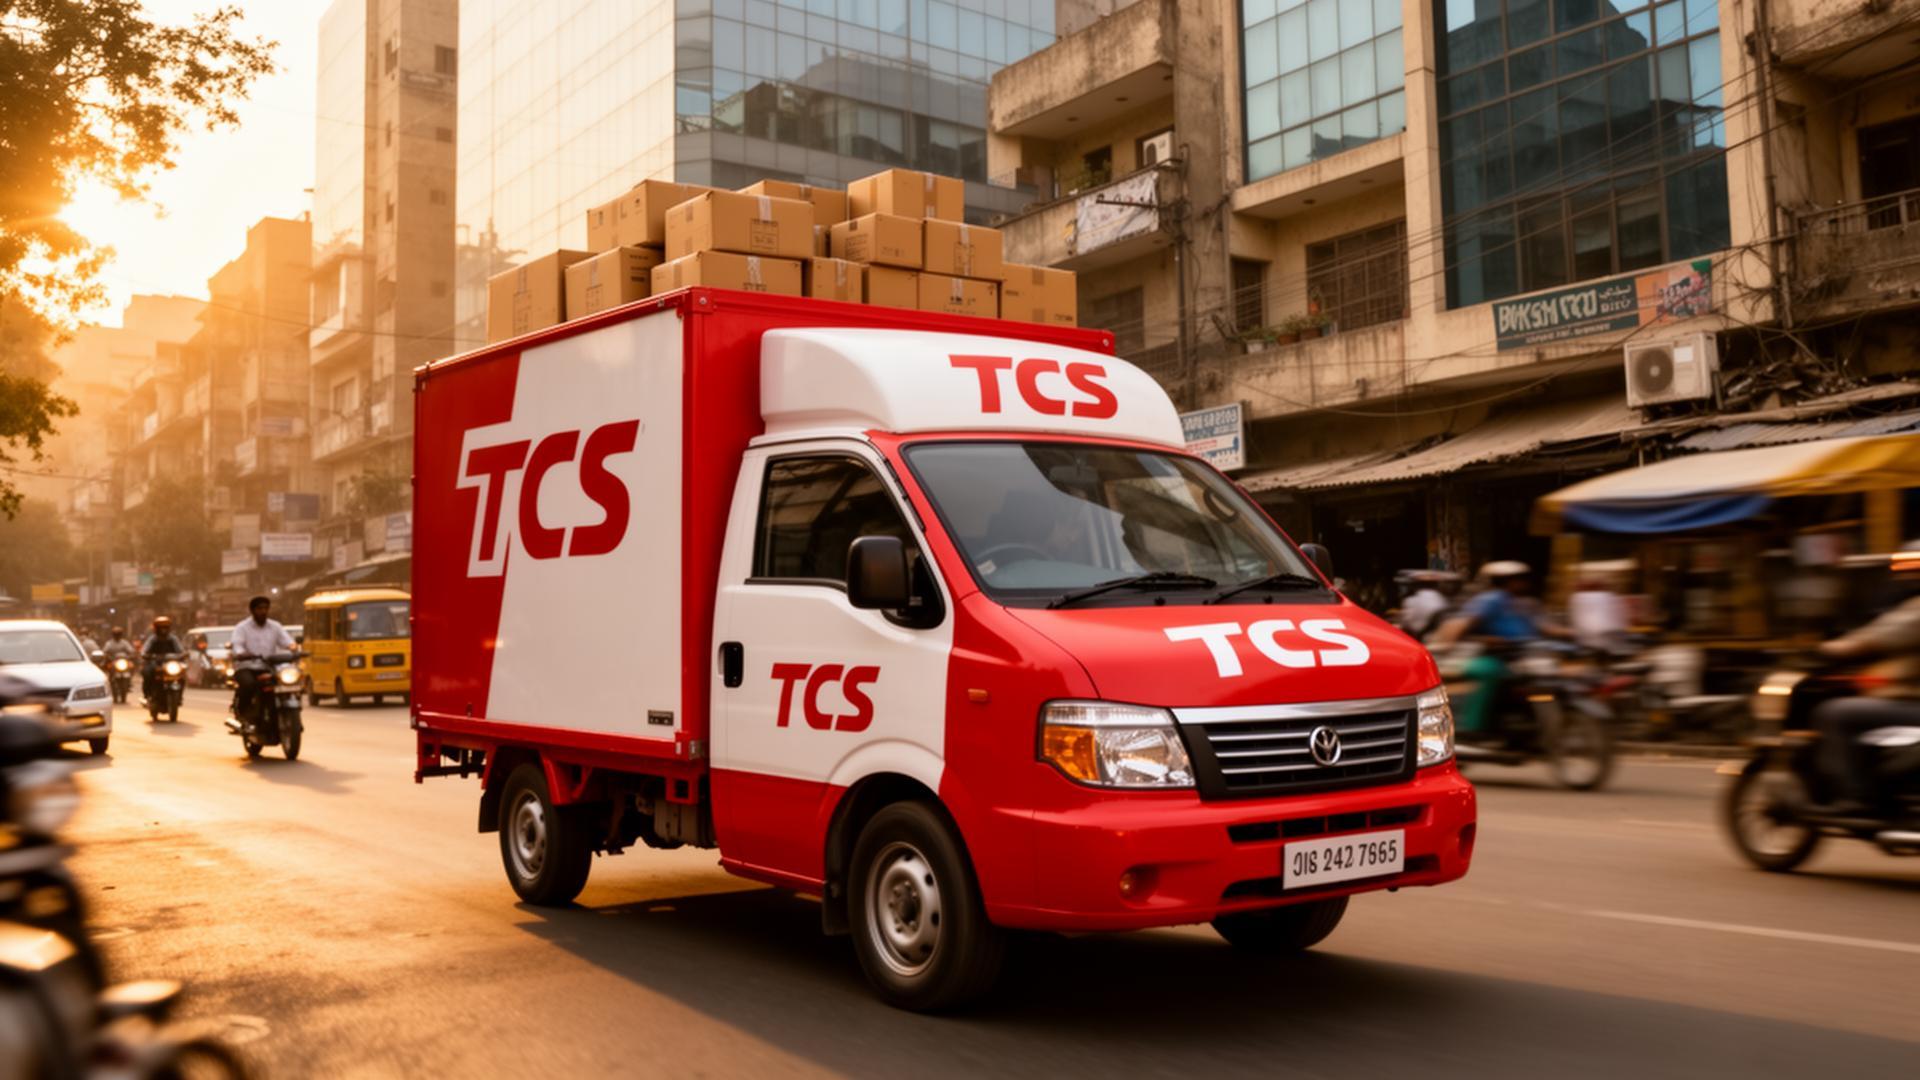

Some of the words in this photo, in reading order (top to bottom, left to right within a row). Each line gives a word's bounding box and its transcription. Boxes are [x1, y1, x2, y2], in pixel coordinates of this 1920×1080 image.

[947, 353, 1119, 420] TCS
[463, 419, 640, 563] TCS
[1163, 619, 1371, 679] TCS
[770, 663, 881, 733] TCS
[1323, 845, 1354, 872] 242
